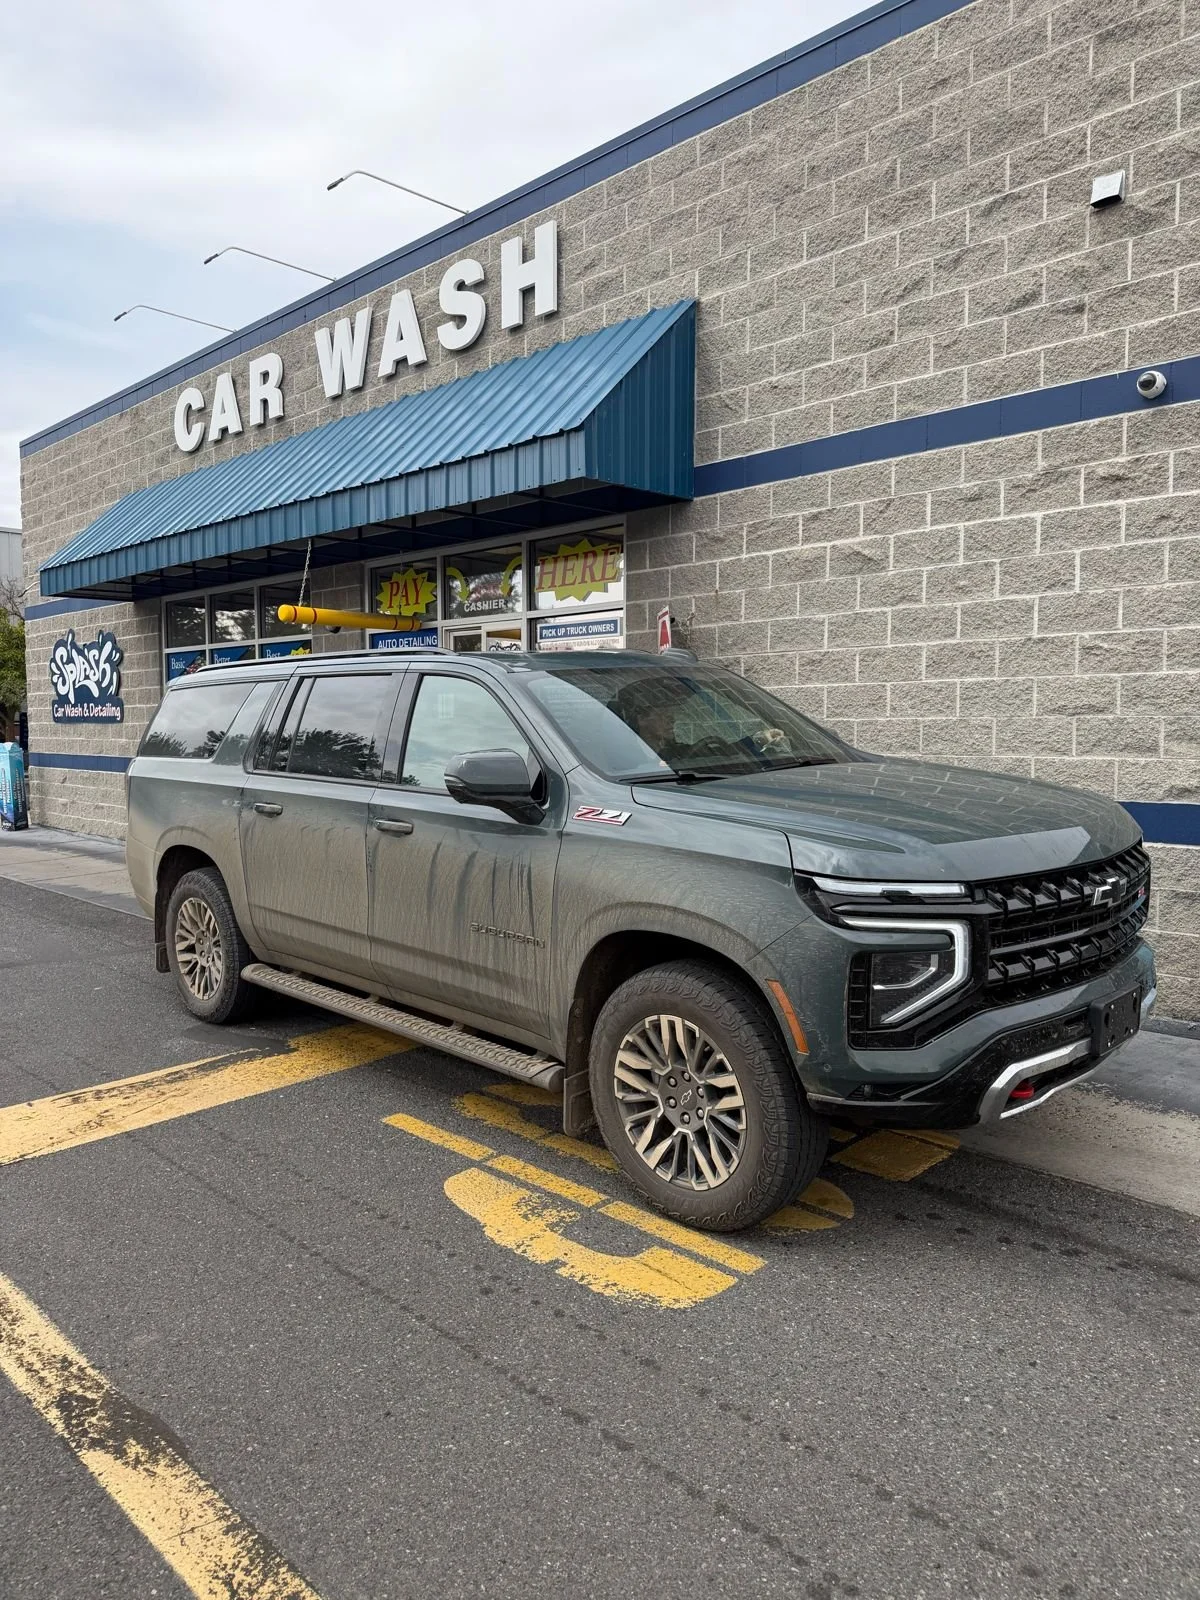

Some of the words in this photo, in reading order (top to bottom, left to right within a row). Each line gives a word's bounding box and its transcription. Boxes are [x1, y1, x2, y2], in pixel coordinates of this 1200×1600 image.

[174, 353, 284, 452] CAR
[315, 220, 558, 398] WASH
[536, 546, 620, 591] HERE
[387, 577, 425, 609] PAY
[464, 599, 505, 612] CASHIER
[542, 628, 556, 638] PICK
[557, 627, 565, 636] UP
[567, 625, 586, 635] TRUCK
[588, 623, 615, 633] OWNERS
[378, 638, 397, 648] AUTO
[399, 635, 437, 647] DETAILING
[171, 658, 185, 669] Basic
[53, 704, 64, 717] Car
[65, 704, 82, 717] Wash
[83, 703, 89, 716] &
[90, 703, 120, 720] Detailing
[471, 922, 545, 948] SUBURBAN
